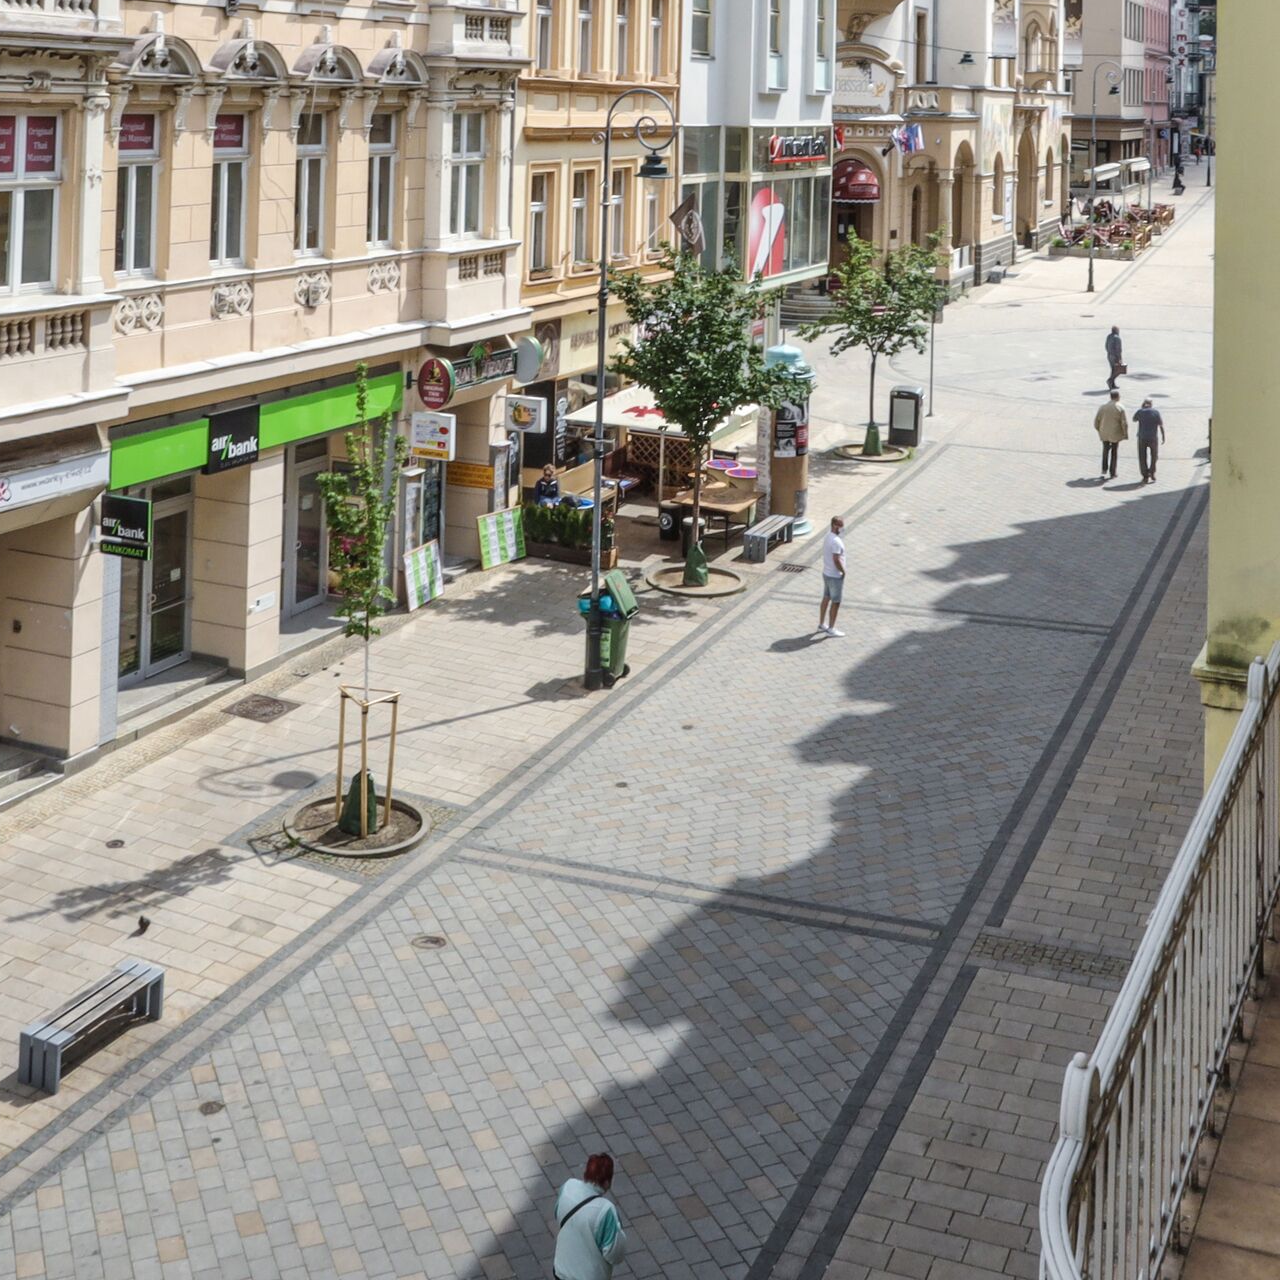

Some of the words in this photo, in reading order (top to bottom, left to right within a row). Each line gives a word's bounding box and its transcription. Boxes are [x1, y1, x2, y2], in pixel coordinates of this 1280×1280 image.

[228, 436, 258, 459] bank
[117, 526, 145, 540] bank
[102, 544, 145, 558] BANKOMAT
